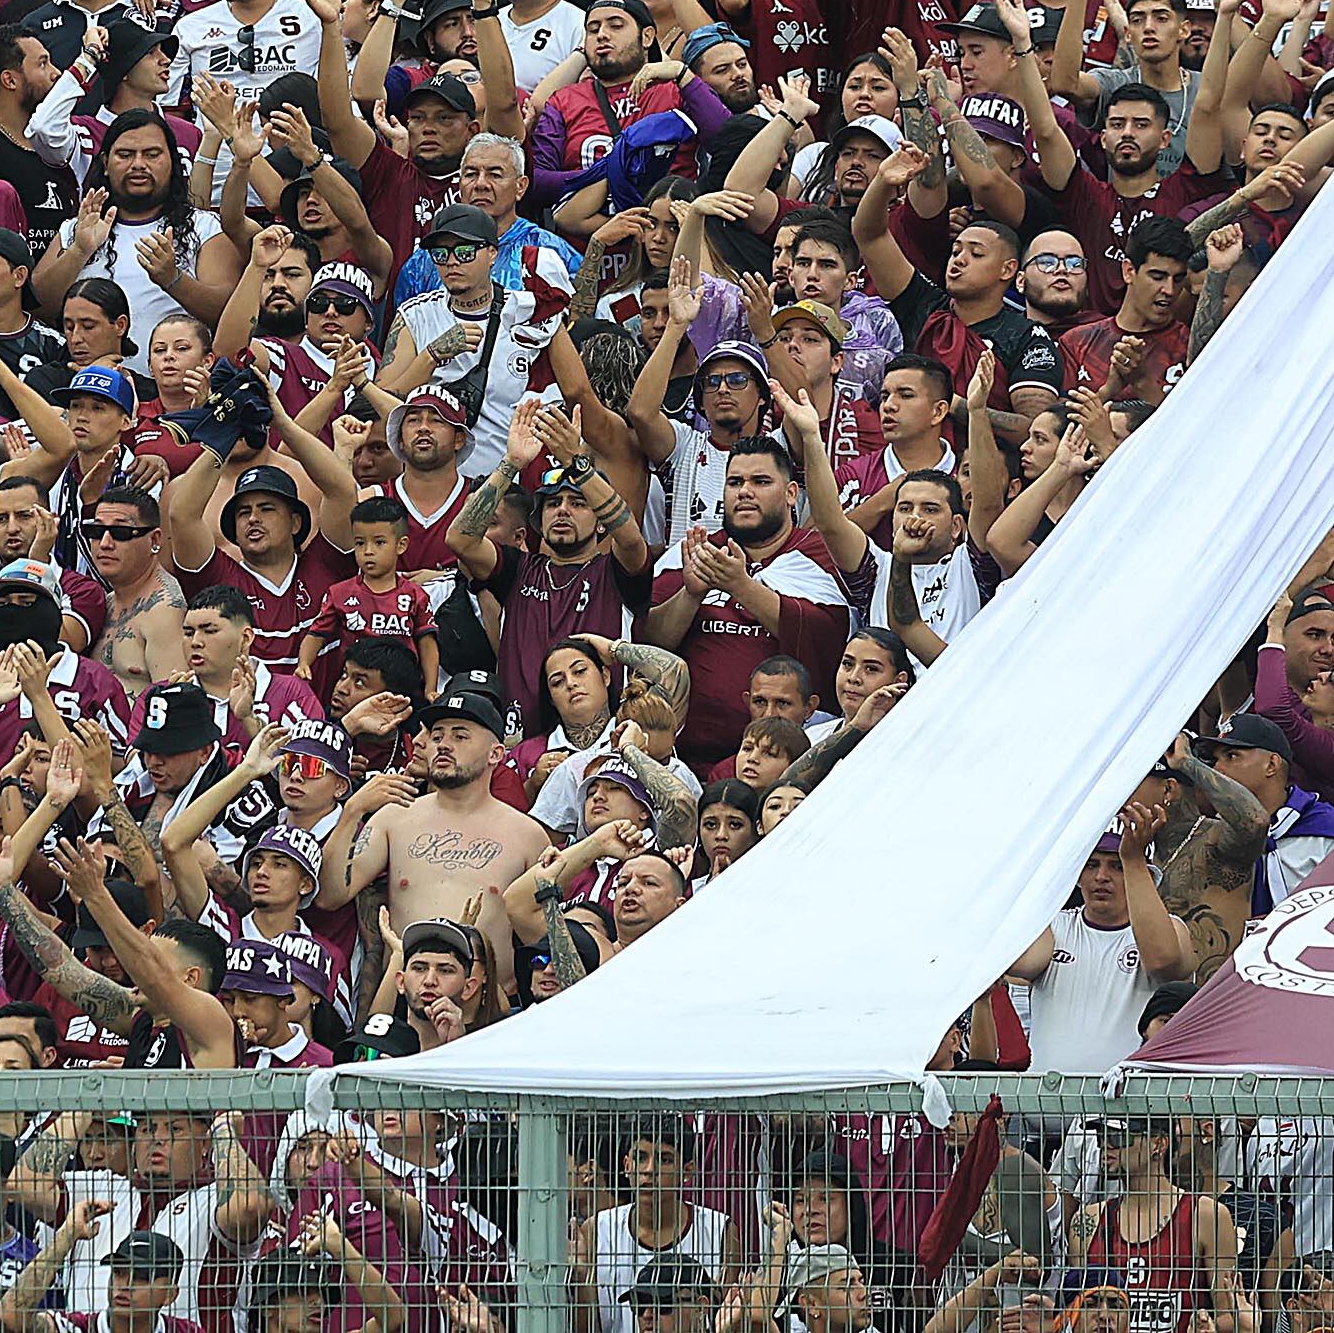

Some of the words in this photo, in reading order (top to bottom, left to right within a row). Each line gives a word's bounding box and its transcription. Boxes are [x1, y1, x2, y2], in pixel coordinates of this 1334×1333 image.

[281, 15, 301, 36] S
[1028, 7, 1046, 28] S
[530, 28, 552, 50] S
[967, 98, 1009, 125] RAFA
[315, 263, 373, 300] ESAMPA
[398, 595, 411, 611] S
[371, 612, 411, 630] BAC
[470, 670, 487, 682] S
[54, 691, 80, 721] S
[147, 697, 167, 729] S
[364, 1014, 393, 1035] S
